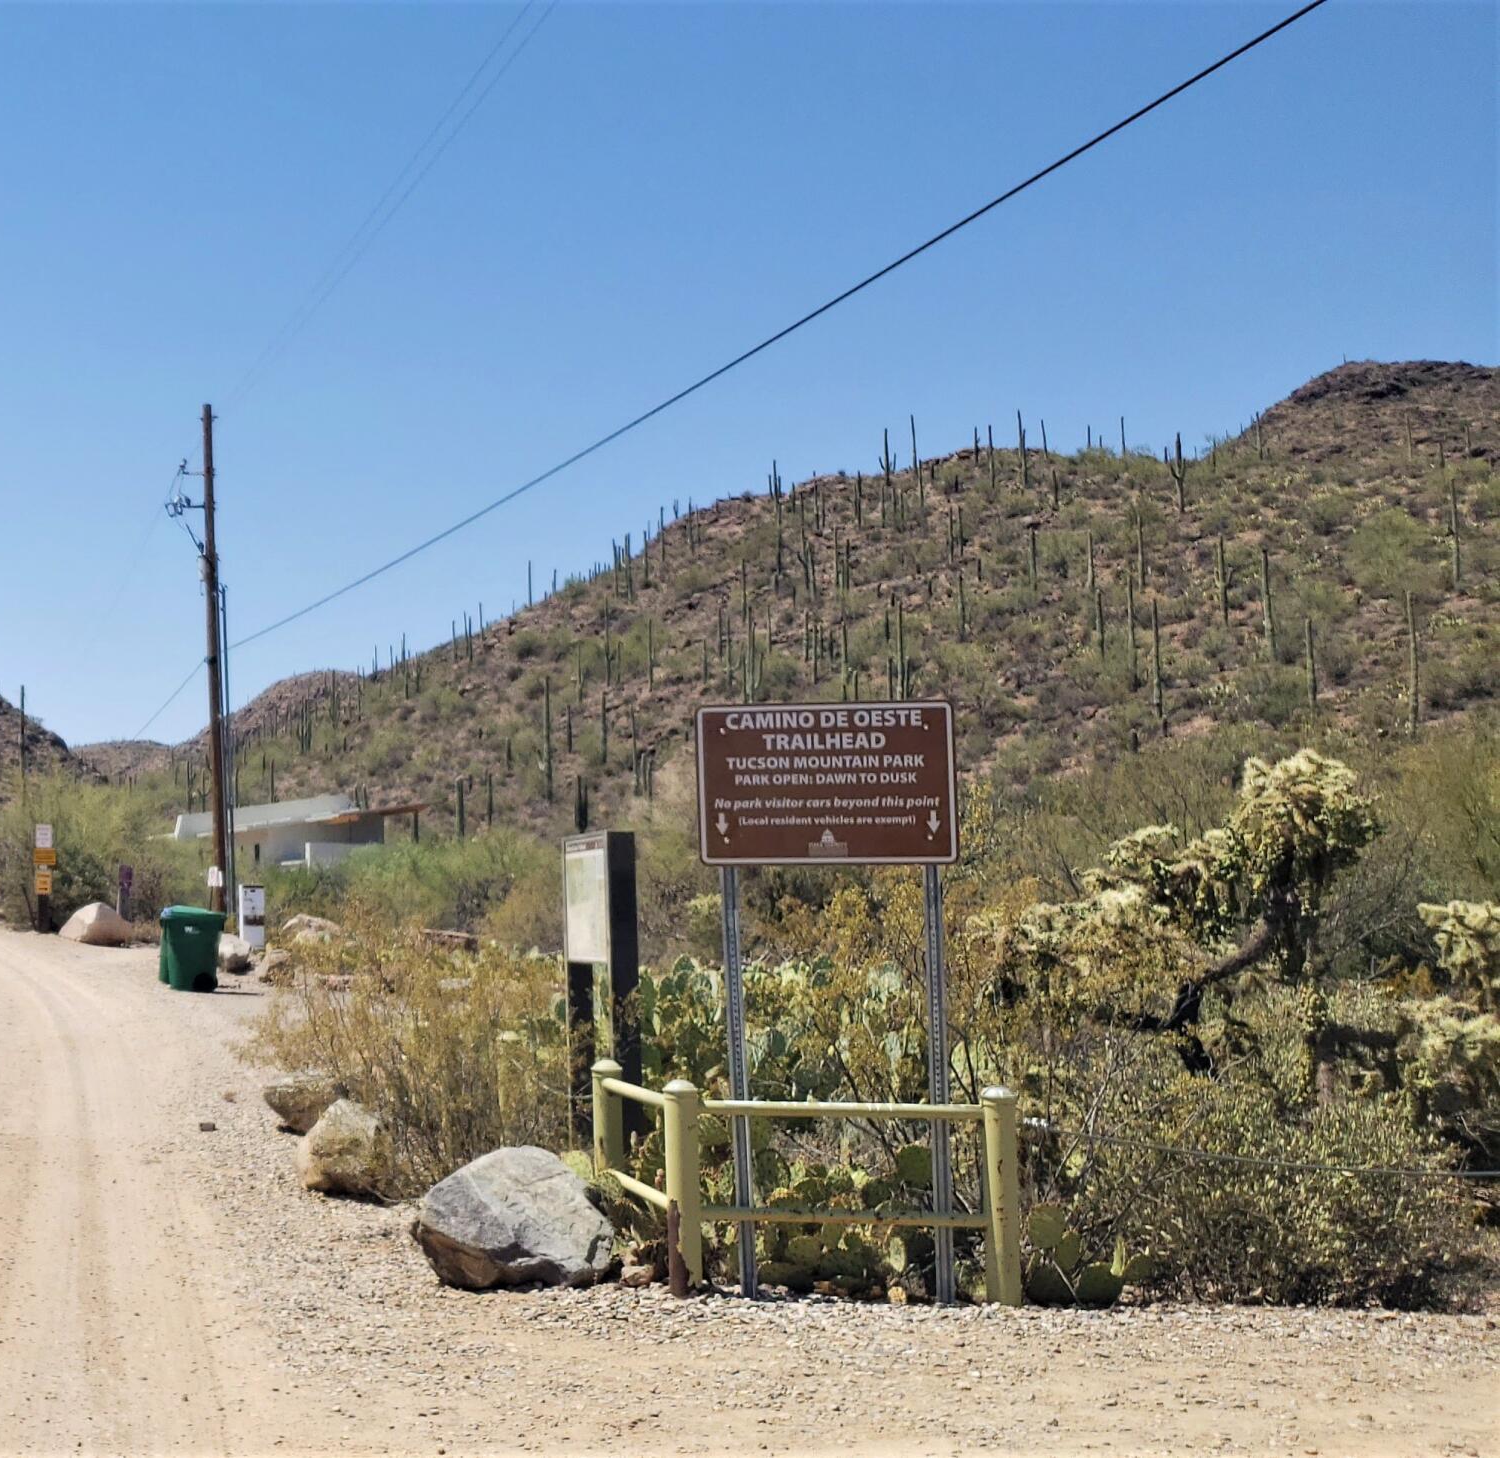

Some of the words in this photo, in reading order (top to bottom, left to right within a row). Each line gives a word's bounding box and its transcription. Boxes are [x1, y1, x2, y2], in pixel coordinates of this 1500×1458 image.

[725, 711, 815, 730] CAMINO
[820, 710, 849, 728] DE
[853, 709, 922, 727] OESTE
[762, 731, 886, 750] TRAILHEAD
[725, 756, 790, 770] TUCSON
[793, 755, 879, 769] MOUNTAIN
[883, 754, 924, 768] PARK
[735, 774, 770, 785] PARK
[772, 773, 813, 785] OPEN:
[815, 773, 857, 784] DAWN
[859, 772, 877, 784] TO
[880, 771, 917, 784] DUSK
[714, 798, 732, 809] No
[733, 797, 762, 812] park
[765, 796, 804, 809] visitor
[806, 798, 832, 808] cars
[833, 796, 880, 810] beyond
[881, 795, 904, 807] this
[906, 795, 940, 810] point
[738, 815, 769, 826] (Local
[770, 815, 812, 826] resident
[813, 814, 854, 825] vehicles
[856, 816, 873, 825] are
[874, 814, 916, 826] exempt)
